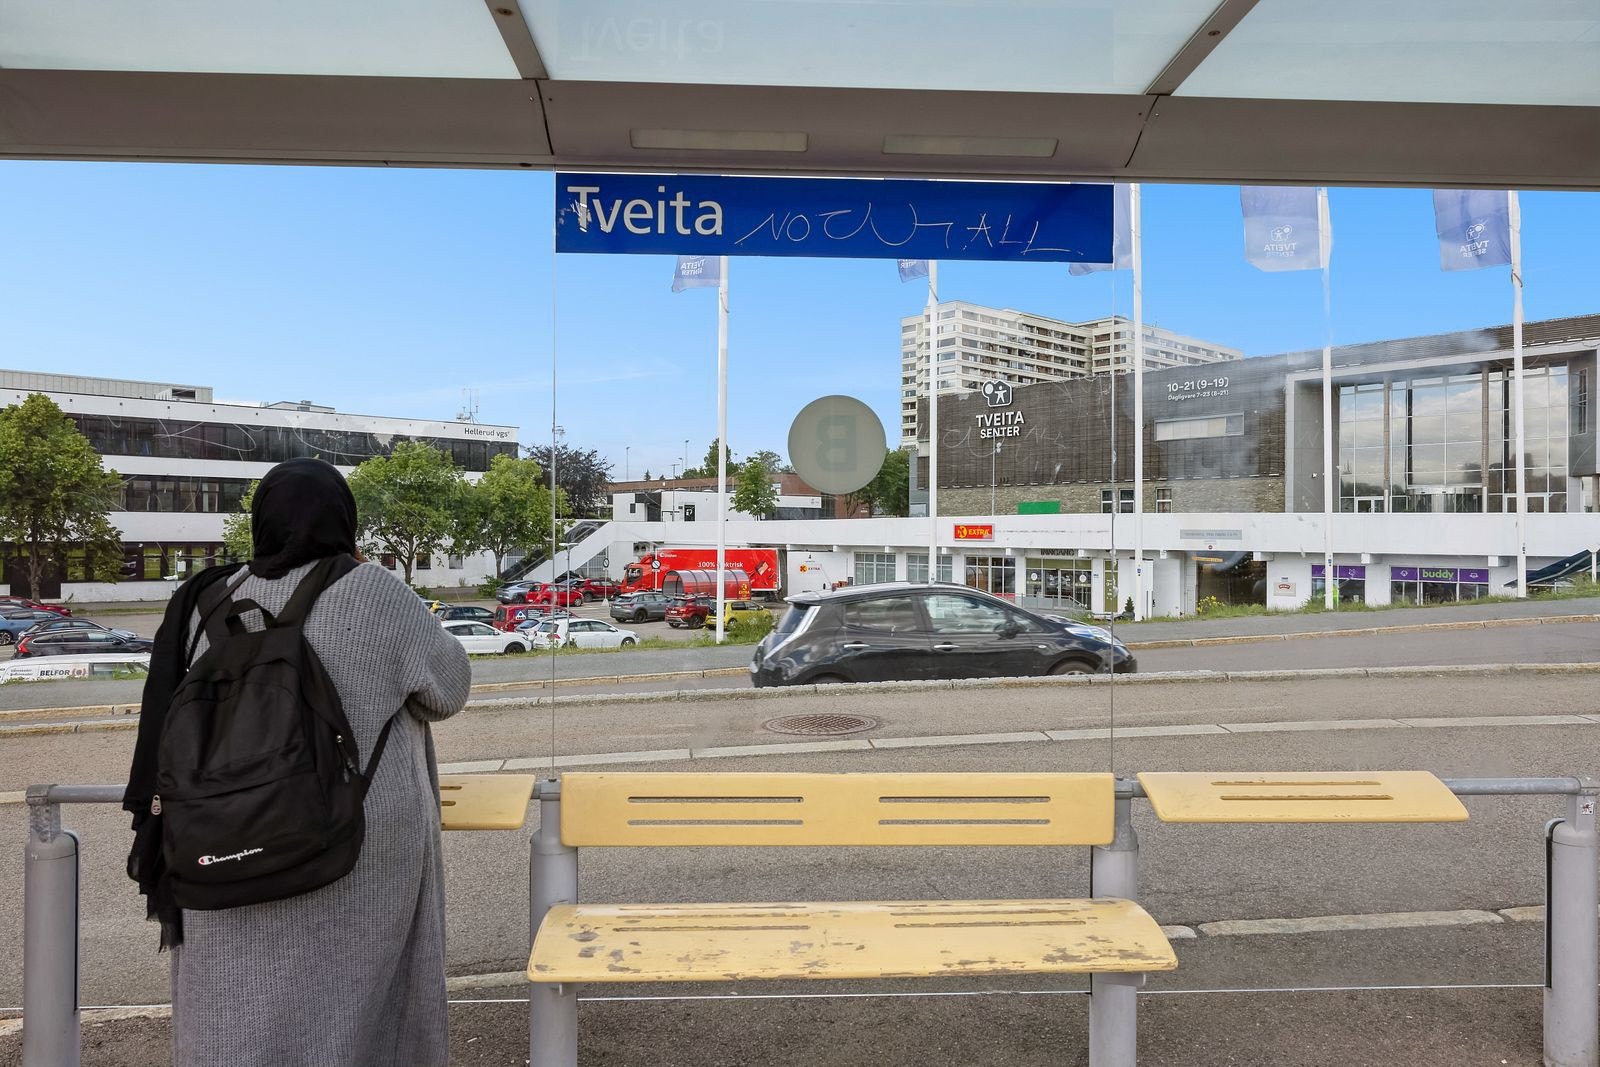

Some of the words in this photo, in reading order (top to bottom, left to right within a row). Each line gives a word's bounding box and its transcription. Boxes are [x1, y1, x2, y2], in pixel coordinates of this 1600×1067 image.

[566, 185, 723, 235] Tveita
[975, 410, 1025, 428] TVEITA
[464, 427, 495, 436] Hellerud
[980, 426, 1020, 439] SENTER
[1422, 569, 1454, 581] buddy
[40, 669, 70, 677] BELFOR
[198, 847, 264, 866] Champion
